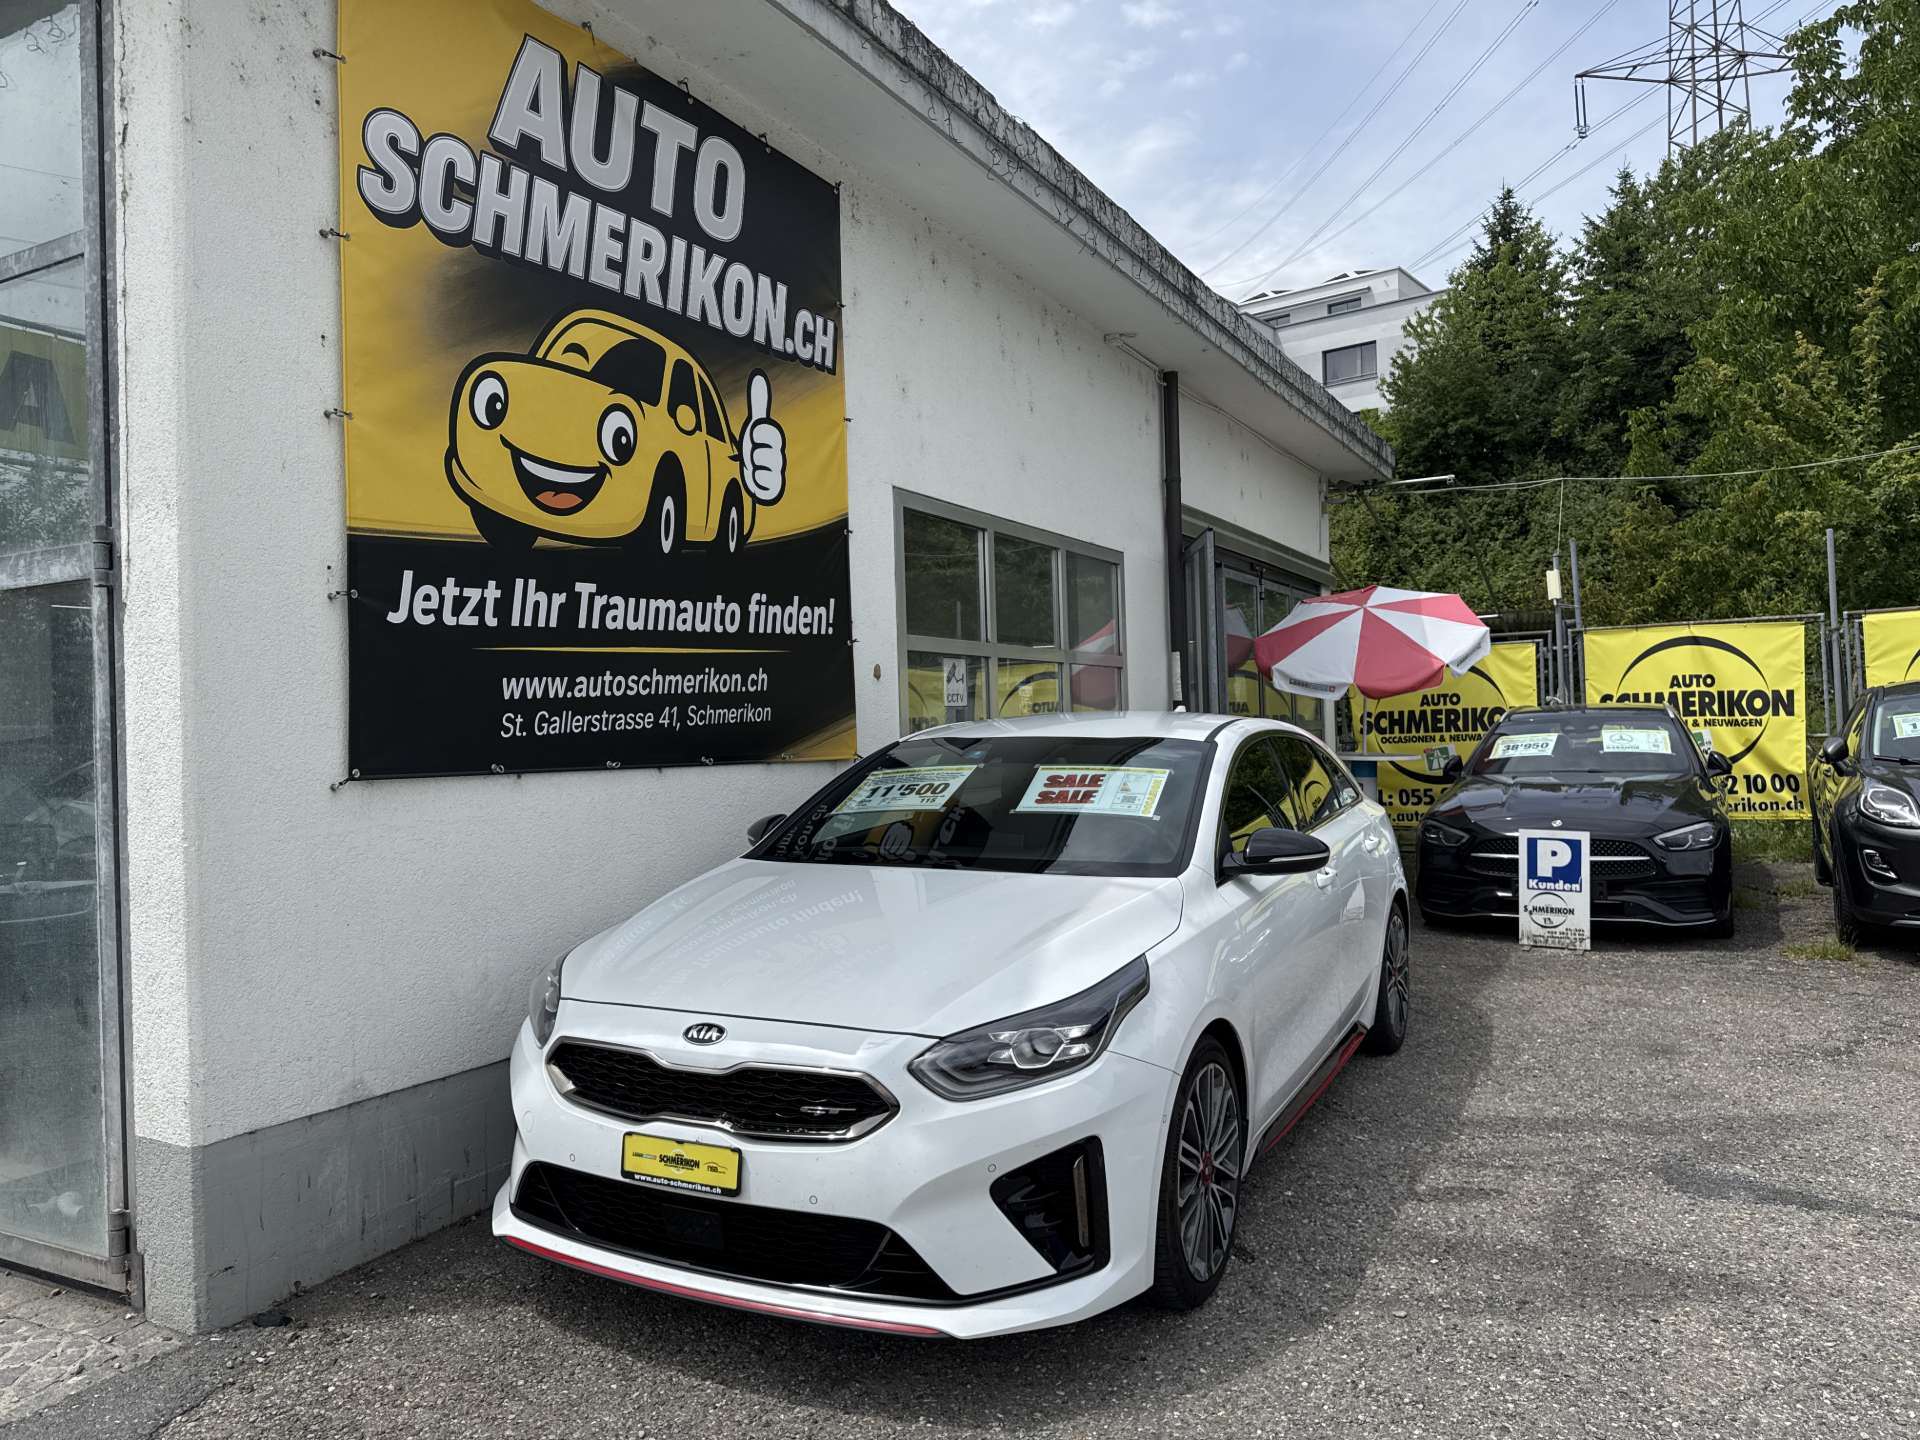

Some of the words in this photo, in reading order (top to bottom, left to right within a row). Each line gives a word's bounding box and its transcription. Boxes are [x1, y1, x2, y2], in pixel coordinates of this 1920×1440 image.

[489, 34, 746, 242] AUTO
[358, 108, 836, 370] SCHMERIKON.CH
[386, 570, 502, 626] Jetzt
[510, 577, 566, 628] Ihr
[574, 582, 740, 634] Traumauto
[748, 593, 835, 635] finden!
[503, 668, 768, 700] www.autoschmerikon.ch
[1669, 674, 1716, 689] AUTO
[947, 693, 964, 704] CCTV
[1420, 693, 1461, 707] AUTO
[501, 713, 527, 738] St.
[534, 708, 653, 735] Gallerstrasse
[659, 706, 681, 731] 41,
[687, 704, 771, 726] Schmerikon
[1360, 707, 1508, 736] SCHMERIKO
[1704, 718, 1763, 728] NEUWAGEN
[1381, 735, 1436, 745] OCCASIONEN
[1502, 742, 1550, 752] 38'950
[1043, 773, 1107, 788] SALE
[1744, 775, 1767, 794] 10
[1770, 773, 1800, 794] 00
[865, 782, 951, 799] 11'500
[1034, 789, 1099, 805] SALE
[1399, 788, 1434, 806] 055
[1537, 839, 1573, 878] P
[1528, 879, 1581, 892] Kunden
[687, 1024, 722, 1041] KIA
[659, 1154, 701, 1169] SCHMERIKON
[634, 1173, 722, 1195] www.auto-schmerikon.ch
